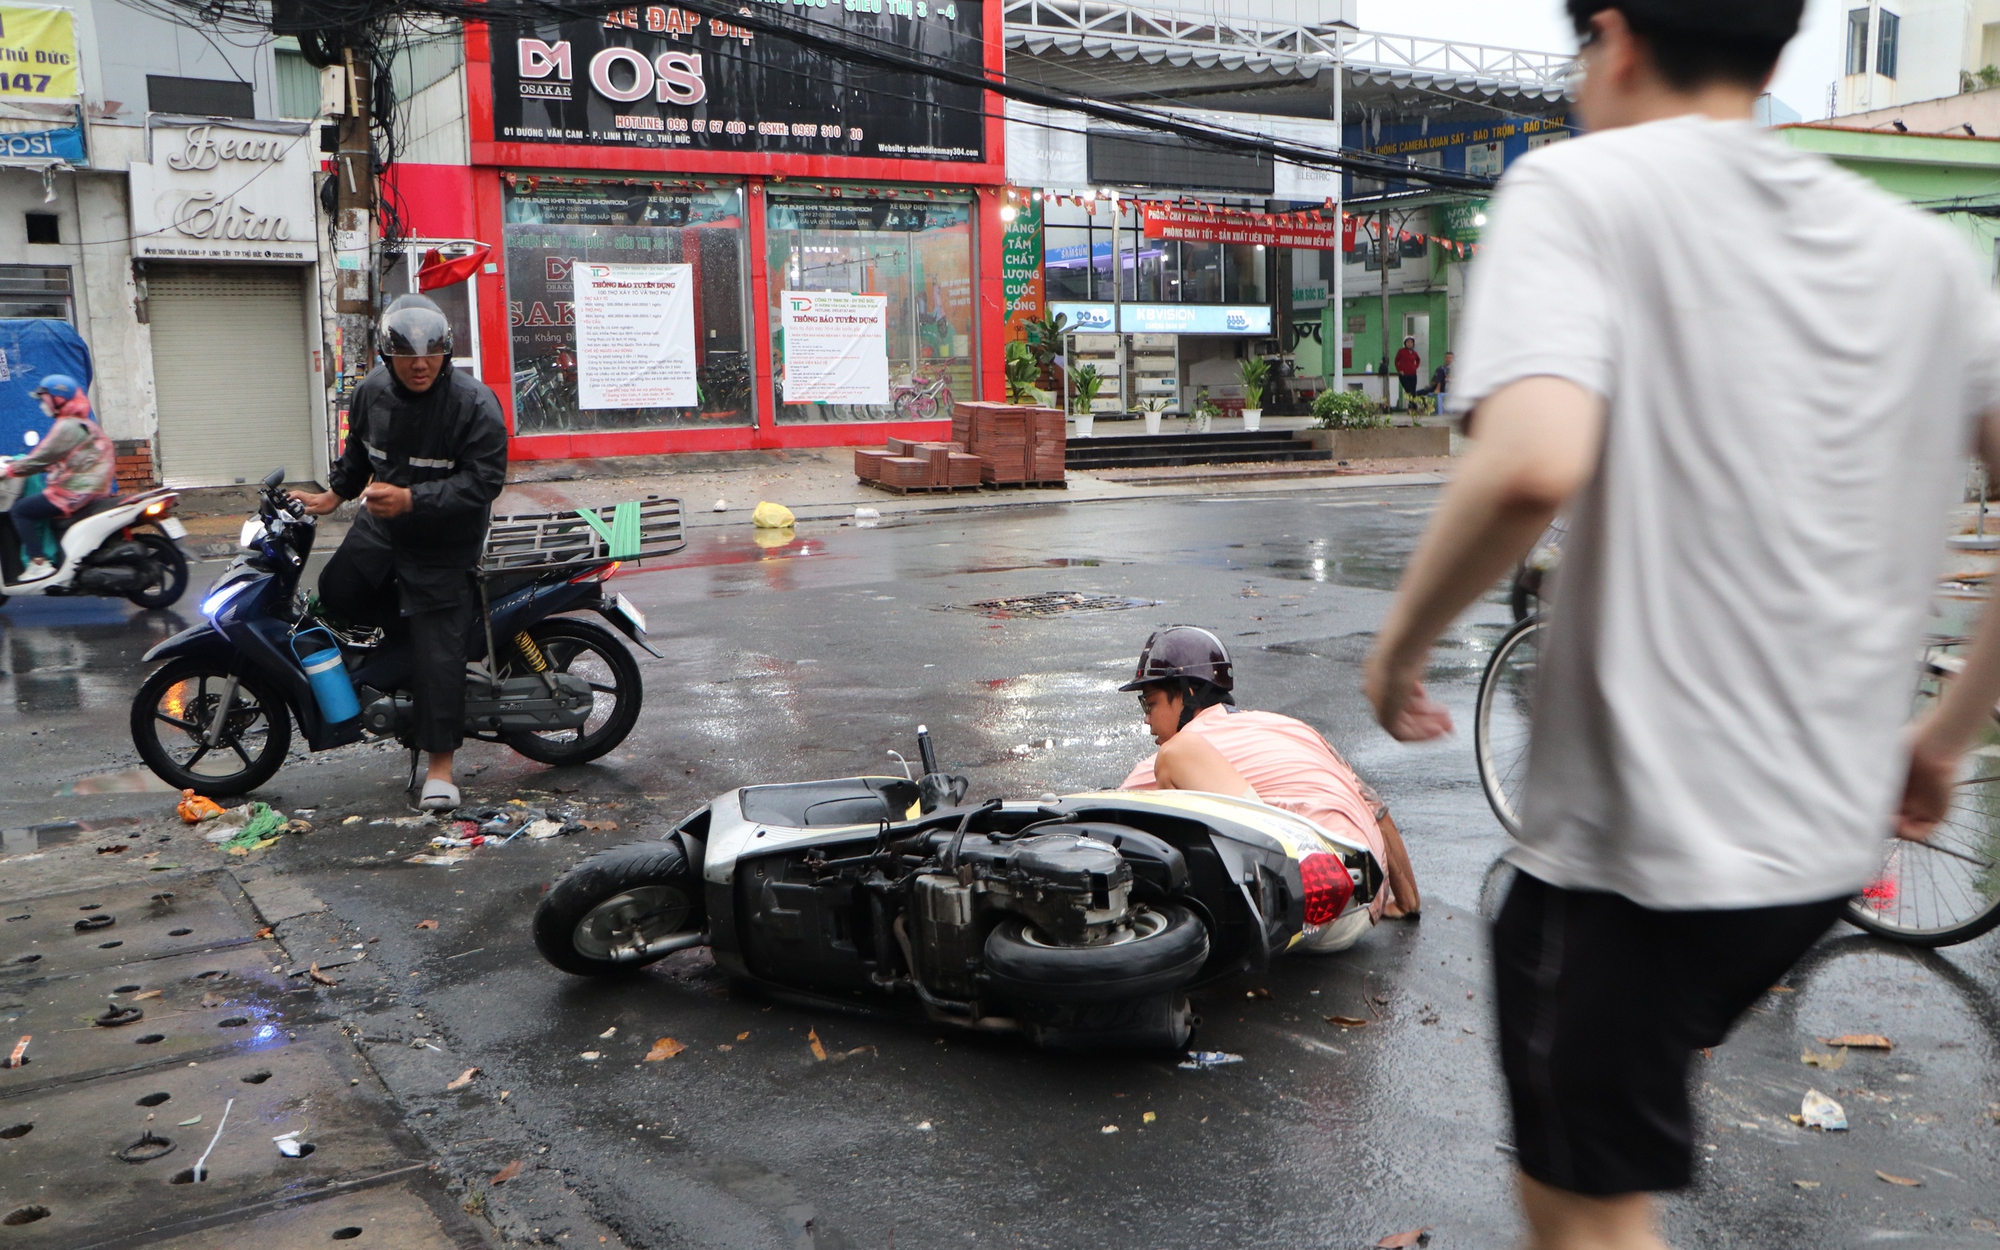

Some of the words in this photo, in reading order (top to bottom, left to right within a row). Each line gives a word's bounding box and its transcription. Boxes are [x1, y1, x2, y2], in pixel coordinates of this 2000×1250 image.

[645, 6, 701, 40] ĐẠP
[35, 50, 70, 65] Đức
[589, 46, 706, 105] OS
[520, 84, 572, 96] OSAKAR
[615, 115, 664, 131] HOTLINE:
[667, 118, 688, 131] 093
[692, 119, 706, 132] 67
[709, 120, 723, 133] 67
[725, 121, 746, 134] 400
[758, 122, 789, 136] CSKH:
[791, 123, 817, 137] 0937
[821, 124, 841, 138] 310
[504, 127, 514, 136] 01
[546, 128, 563, 138] VĂN
[565, 129, 583, 139] CAM
[603, 132, 620, 141] LINH
[623, 131, 638, 142] TÂY
[657, 132, 672, 143] THỦ
[675, 133, 691, 144] ĐỨC
[1400, 139, 1428, 152] CAMERA
[1429, 135, 1449, 148] QUAN
[1450, 131, 1465, 145] SÁT
[1473, 128, 1488, 142] BÁO
[1491, 123, 1515, 139] TRỘM
[1523, 119, 1540, 134] BÁO
[878, 143, 906, 153] Website:
[907, 144, 979, 157] sieuthidienmay304.com
[174, 190, 291, 241] Thìn
[1148, 209, 1167, 220] PHÒN
[1004, 221, 1035, 233] NÂNG
[1163, 225, 1182, 238] PHÒNG
[1005, 251, 1035, 265] CHẤT
[1061, 247, 1088, 259] SAMSUN
[1002, 269, 1039, 281] LƯỢNG
[618, 281, 632, 289] BÁO
[657, 282, 676, 290] DỤNG
[1006, 283, 1035, 297] CUỘC
[1317, 287, 1325, 299] XE
[1006, 297, 1036, 311] SỐNG
[820, 315, 833, 323] BÁO
[1136, 308, 1196, 320] KBVISION
[1145, 322, 1164, 330] CAMERA
[535, 330, 561, 344] Khẳng
